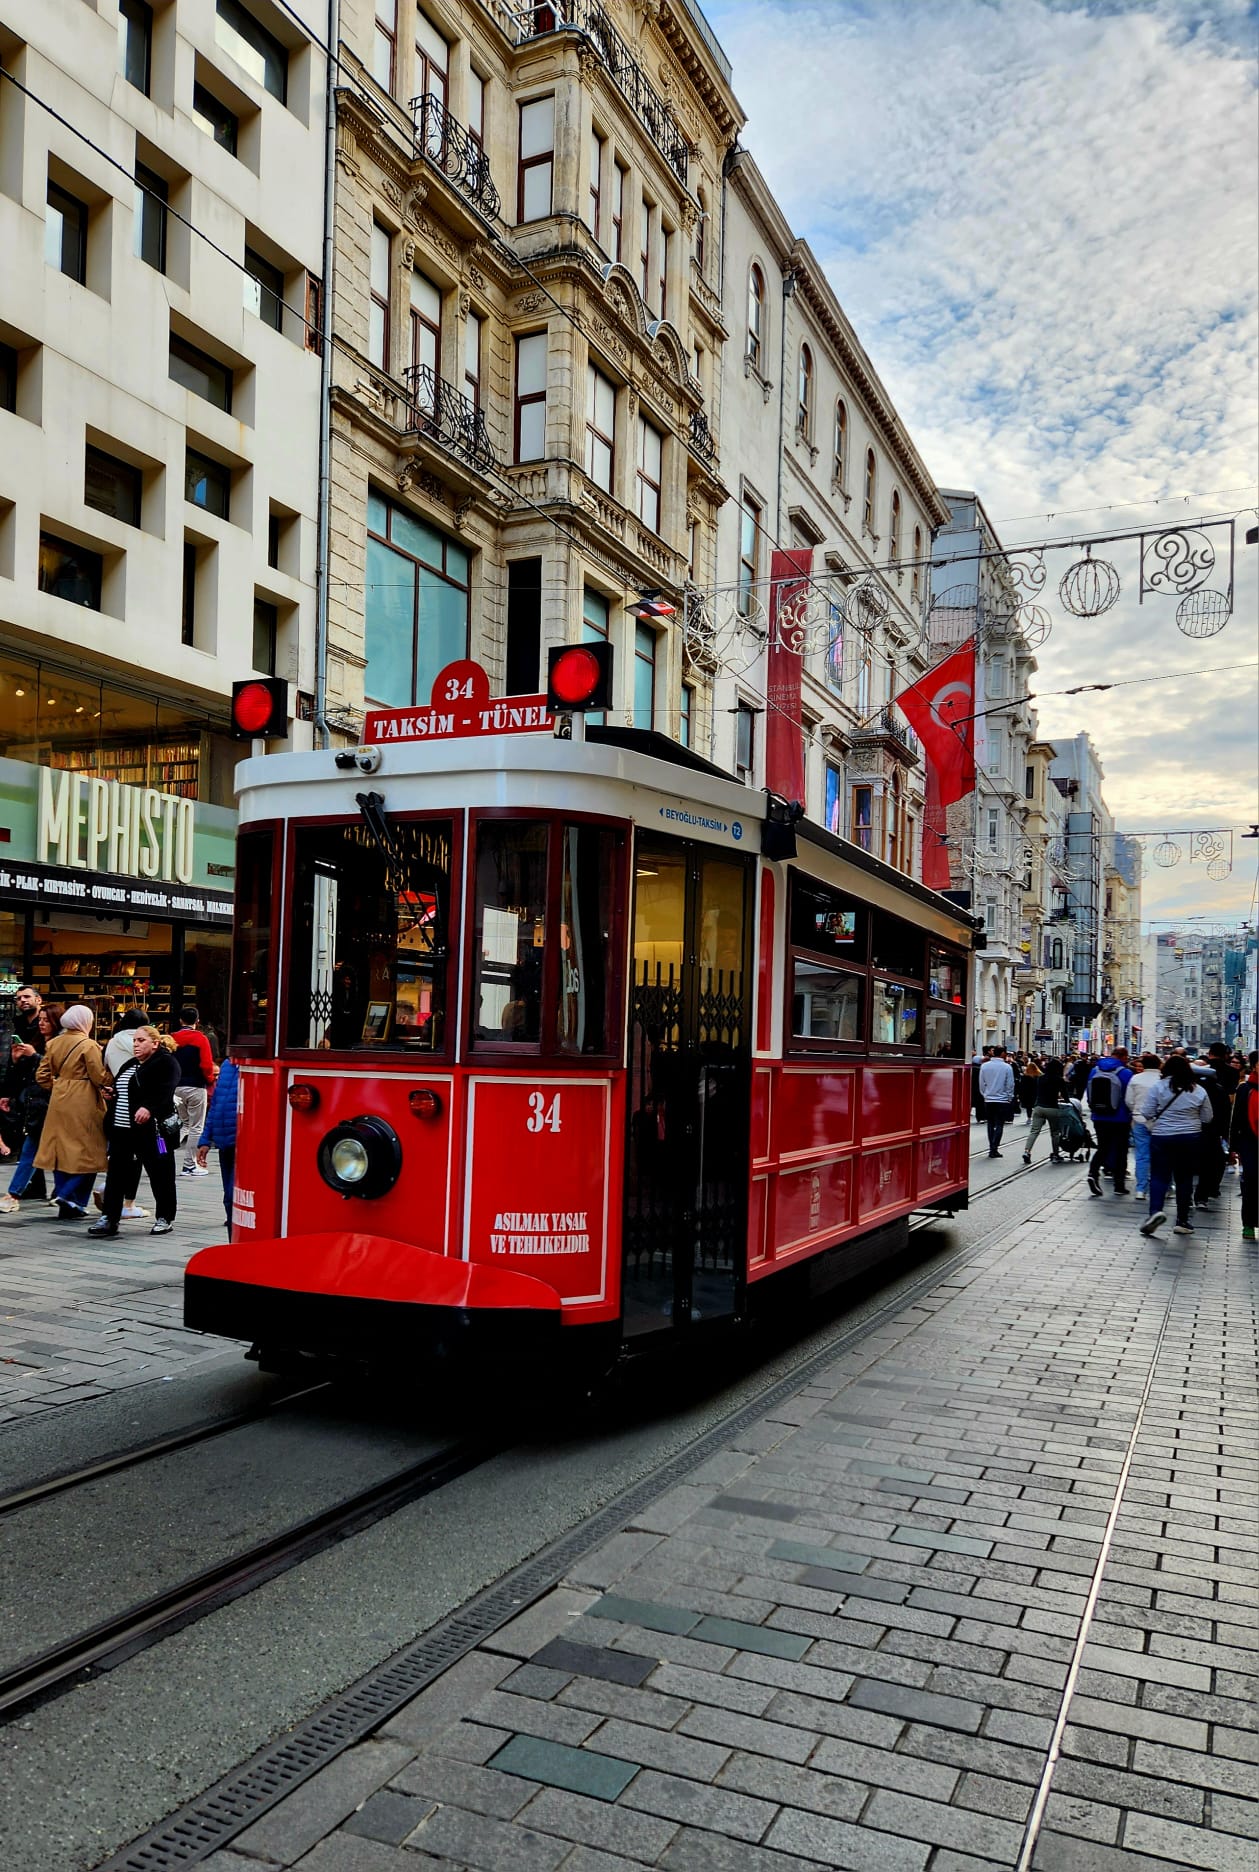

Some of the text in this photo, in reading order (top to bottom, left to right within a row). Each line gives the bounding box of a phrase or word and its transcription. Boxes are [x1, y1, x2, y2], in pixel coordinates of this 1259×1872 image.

[444, 677, 474, 701] 34
[374, 710, 455, 739] TAKSİM
[479, 703, 551, 730] TÜNEL
[37, 766, 194, 884] MEPHISTO
[666, 808, 722, 832] BEYOĞLU-TAKSİM
[16, 874, 39, 891] PLAK
[43, 879, 86, 897] KIRTASİYE
[91, 885, 126, 902] OYUNCAK
[131, 889, 167, 908] HEDİYELİK
[171, 896, 205, 912] SANATSAL
[527, 1091, 562, 1132] 34
[494, 1212, 587, 1231] ASILMAK YASAK
[490, 1234, 590, 1254] VE TEHLIKELIDIR
